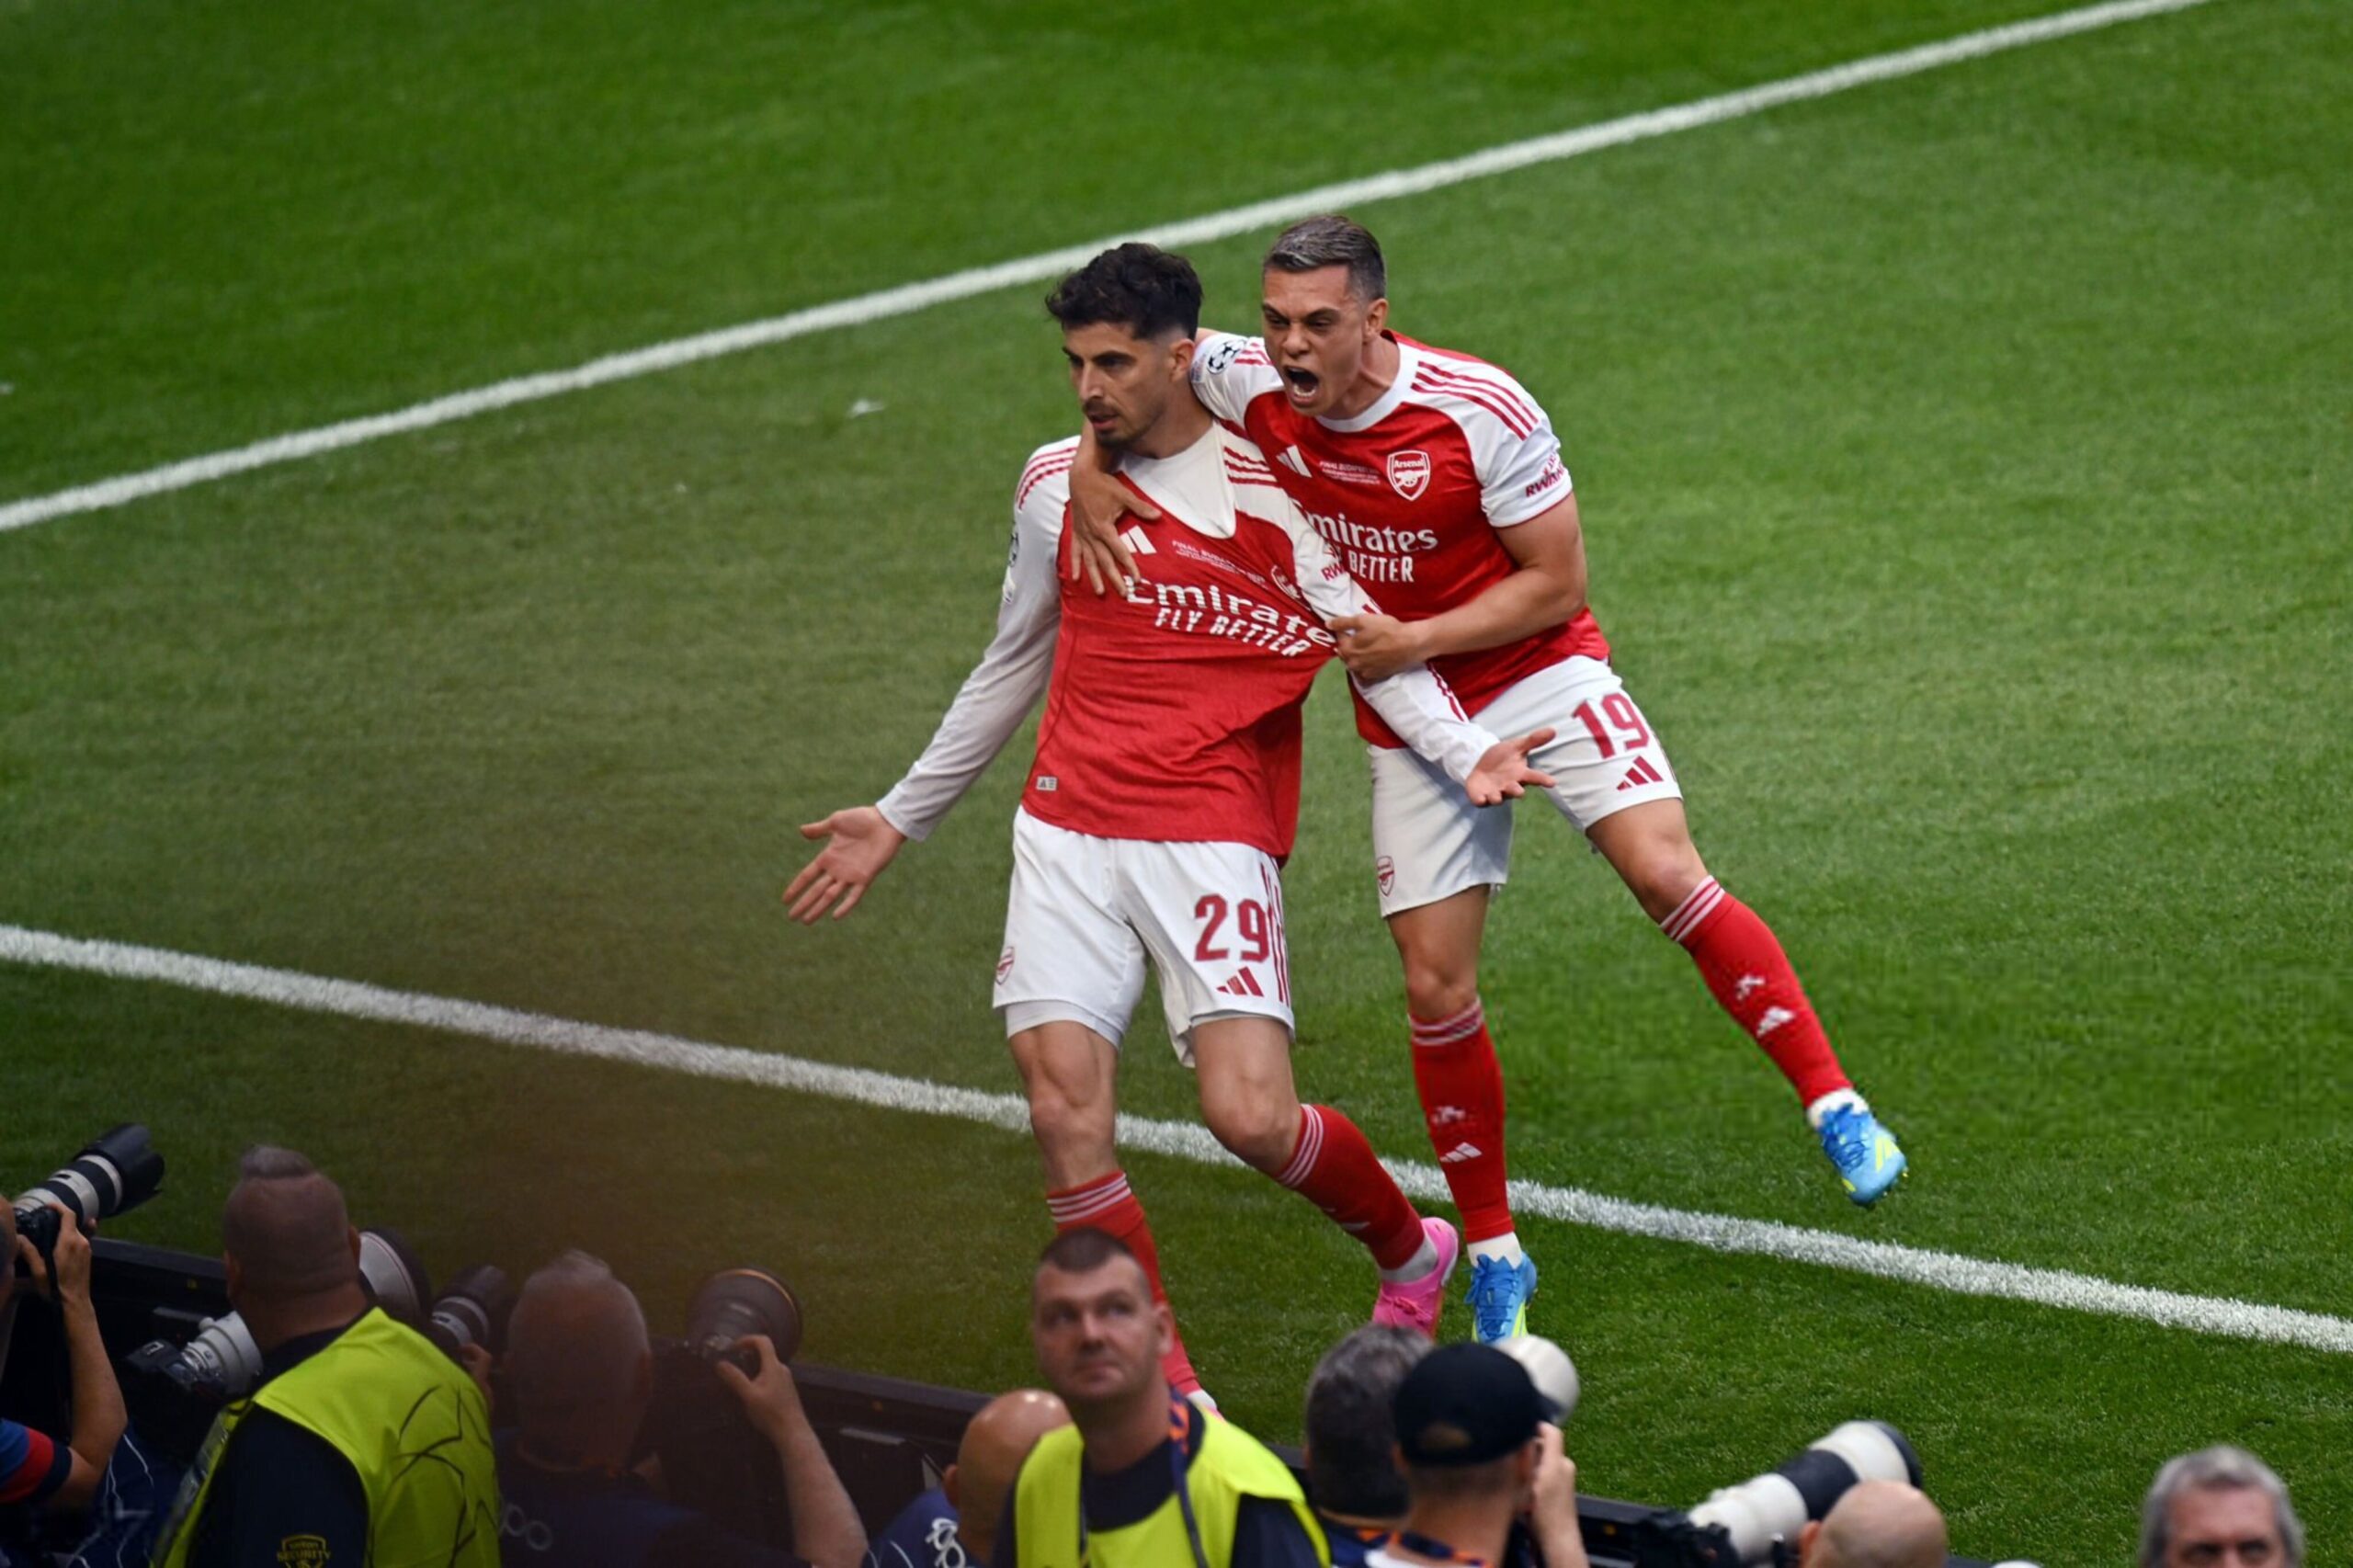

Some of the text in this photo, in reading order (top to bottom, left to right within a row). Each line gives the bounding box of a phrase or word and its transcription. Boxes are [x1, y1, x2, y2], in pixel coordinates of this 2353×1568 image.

[1290, 499, 1438, 554] mirates
[1347, 550, 1415, 583] BETTER
[1122, 574, 1339, 655] Emirate
[1154, 607, 1313, 657] FLY BETTER
[1572, 691, 1650, 760] 19
[1194, 893, 1270, 963] 29
